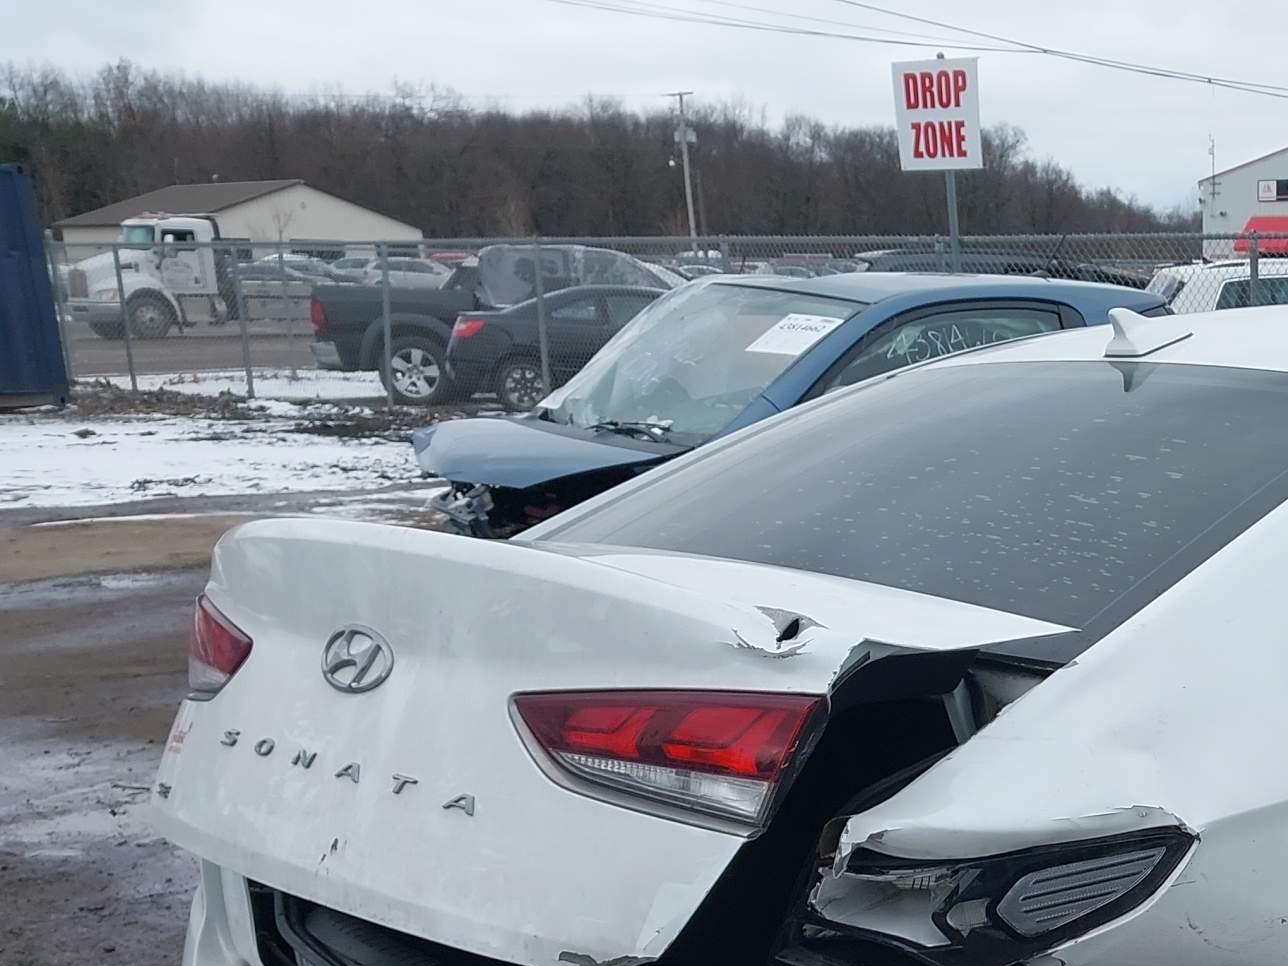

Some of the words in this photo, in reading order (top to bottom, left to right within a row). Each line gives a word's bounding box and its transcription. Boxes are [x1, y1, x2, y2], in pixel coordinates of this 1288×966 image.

[903, 69, 967, 110] DROP
[911, 120, 967, 159] ZONE
[220, 728, 476, 817] SONATA
